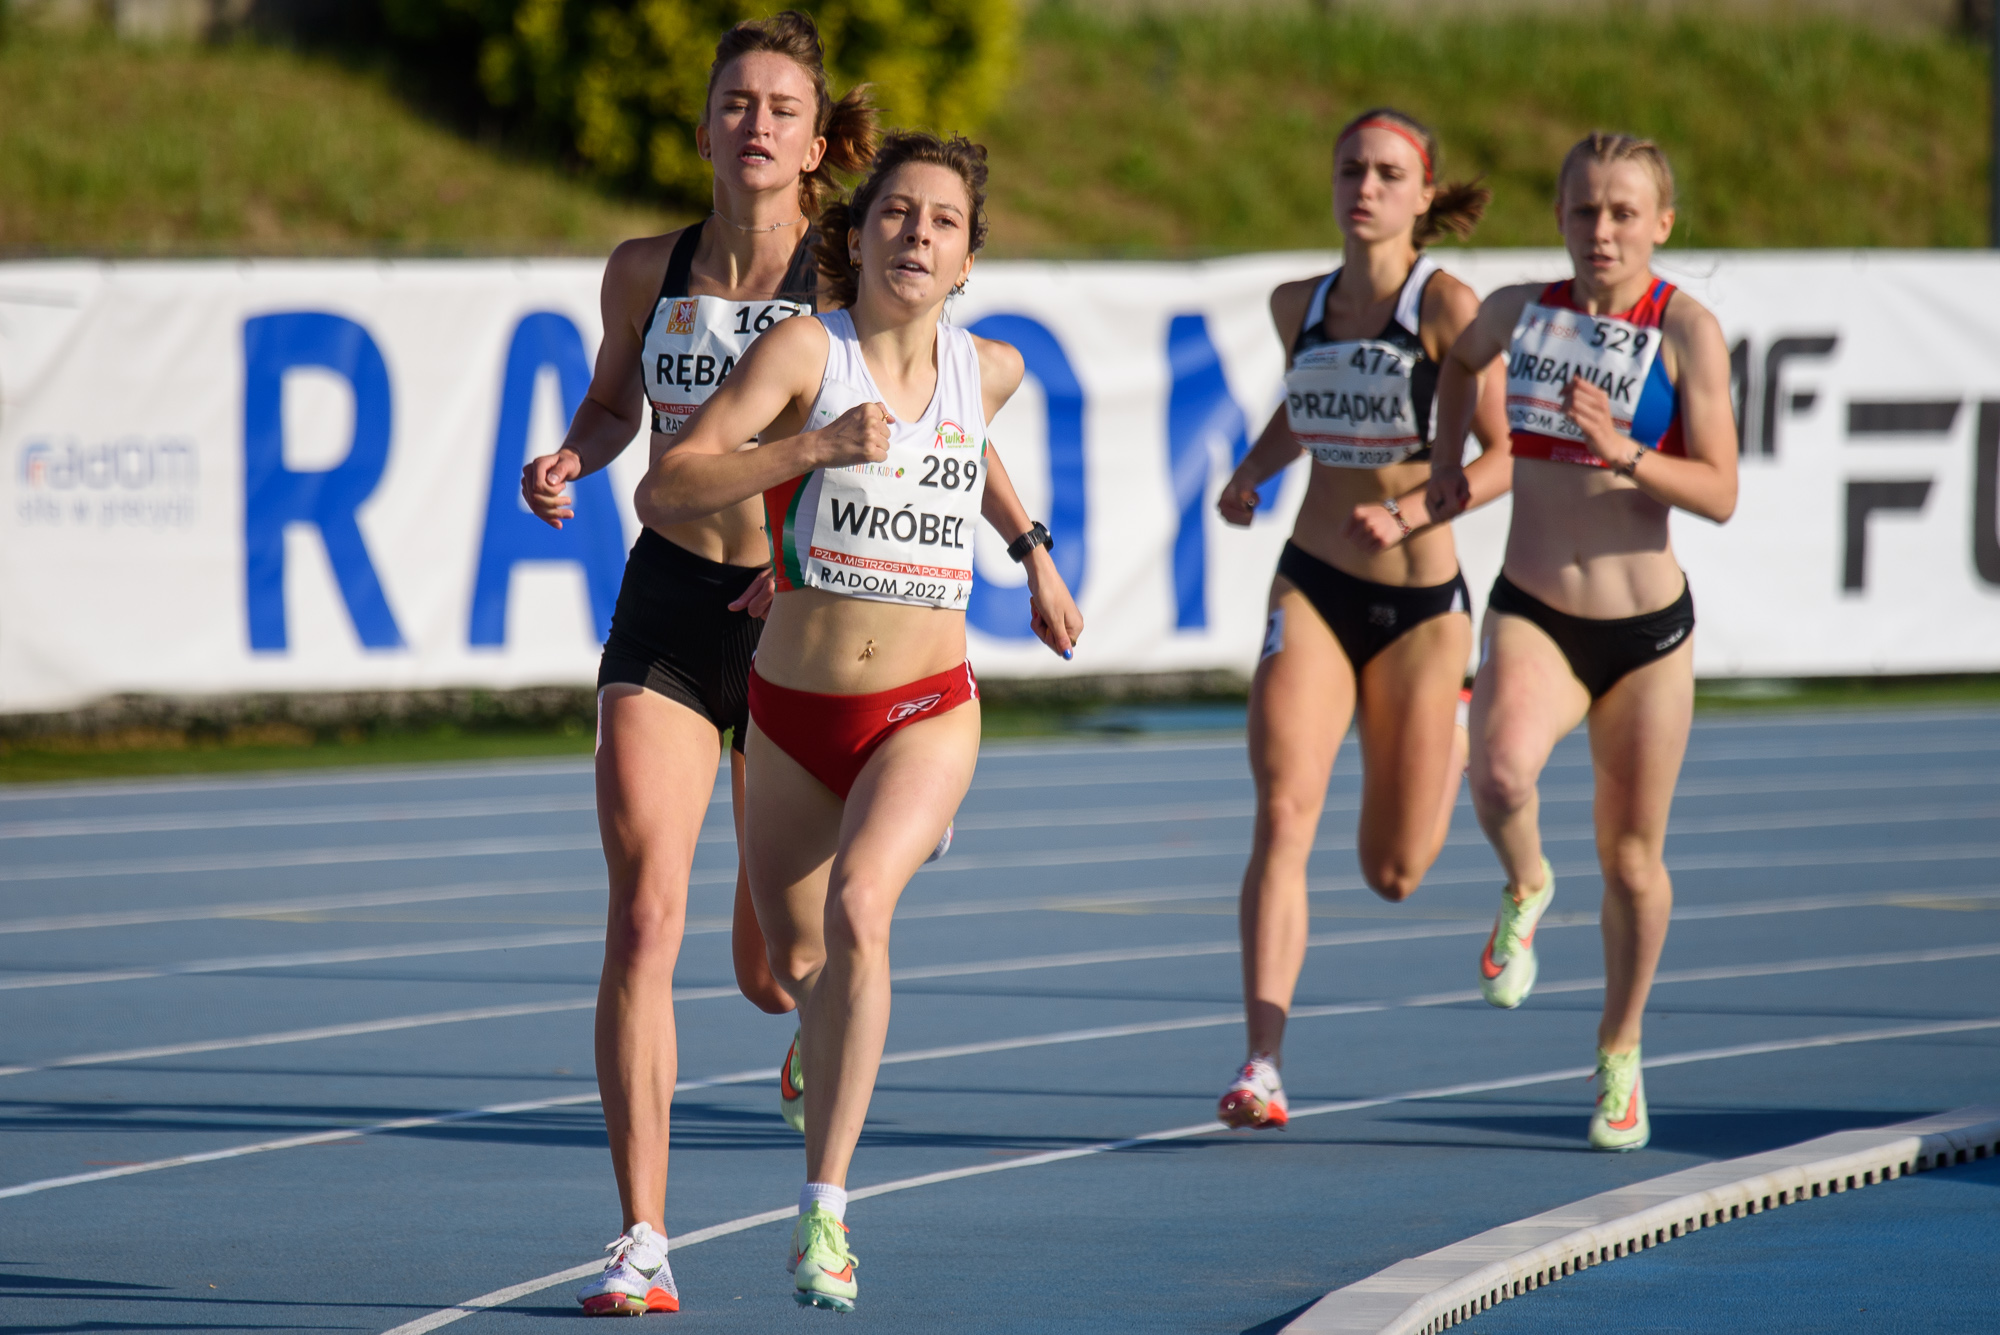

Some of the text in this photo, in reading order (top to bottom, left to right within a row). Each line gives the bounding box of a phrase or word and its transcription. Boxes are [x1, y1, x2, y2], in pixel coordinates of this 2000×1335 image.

[1589, 321, 1649, 359] 529
[656, 353, 735, 392] RĘBA
[1350, 347, 1401, 376] 472
[1509, 352, 1637, 403] URBANIAK
[1288, 391, 1407, 427] PRZĄDKA
[877, 464, 894, 478] KIDS
[918, 454, 978, 493] 289
[831, 497, 964, 550] WRÓBEL
[814, 548, 969, 581] PZLA MISTRZOSTWA POLSKI U20
[820, 566, 946, 600] RADOM 2022
